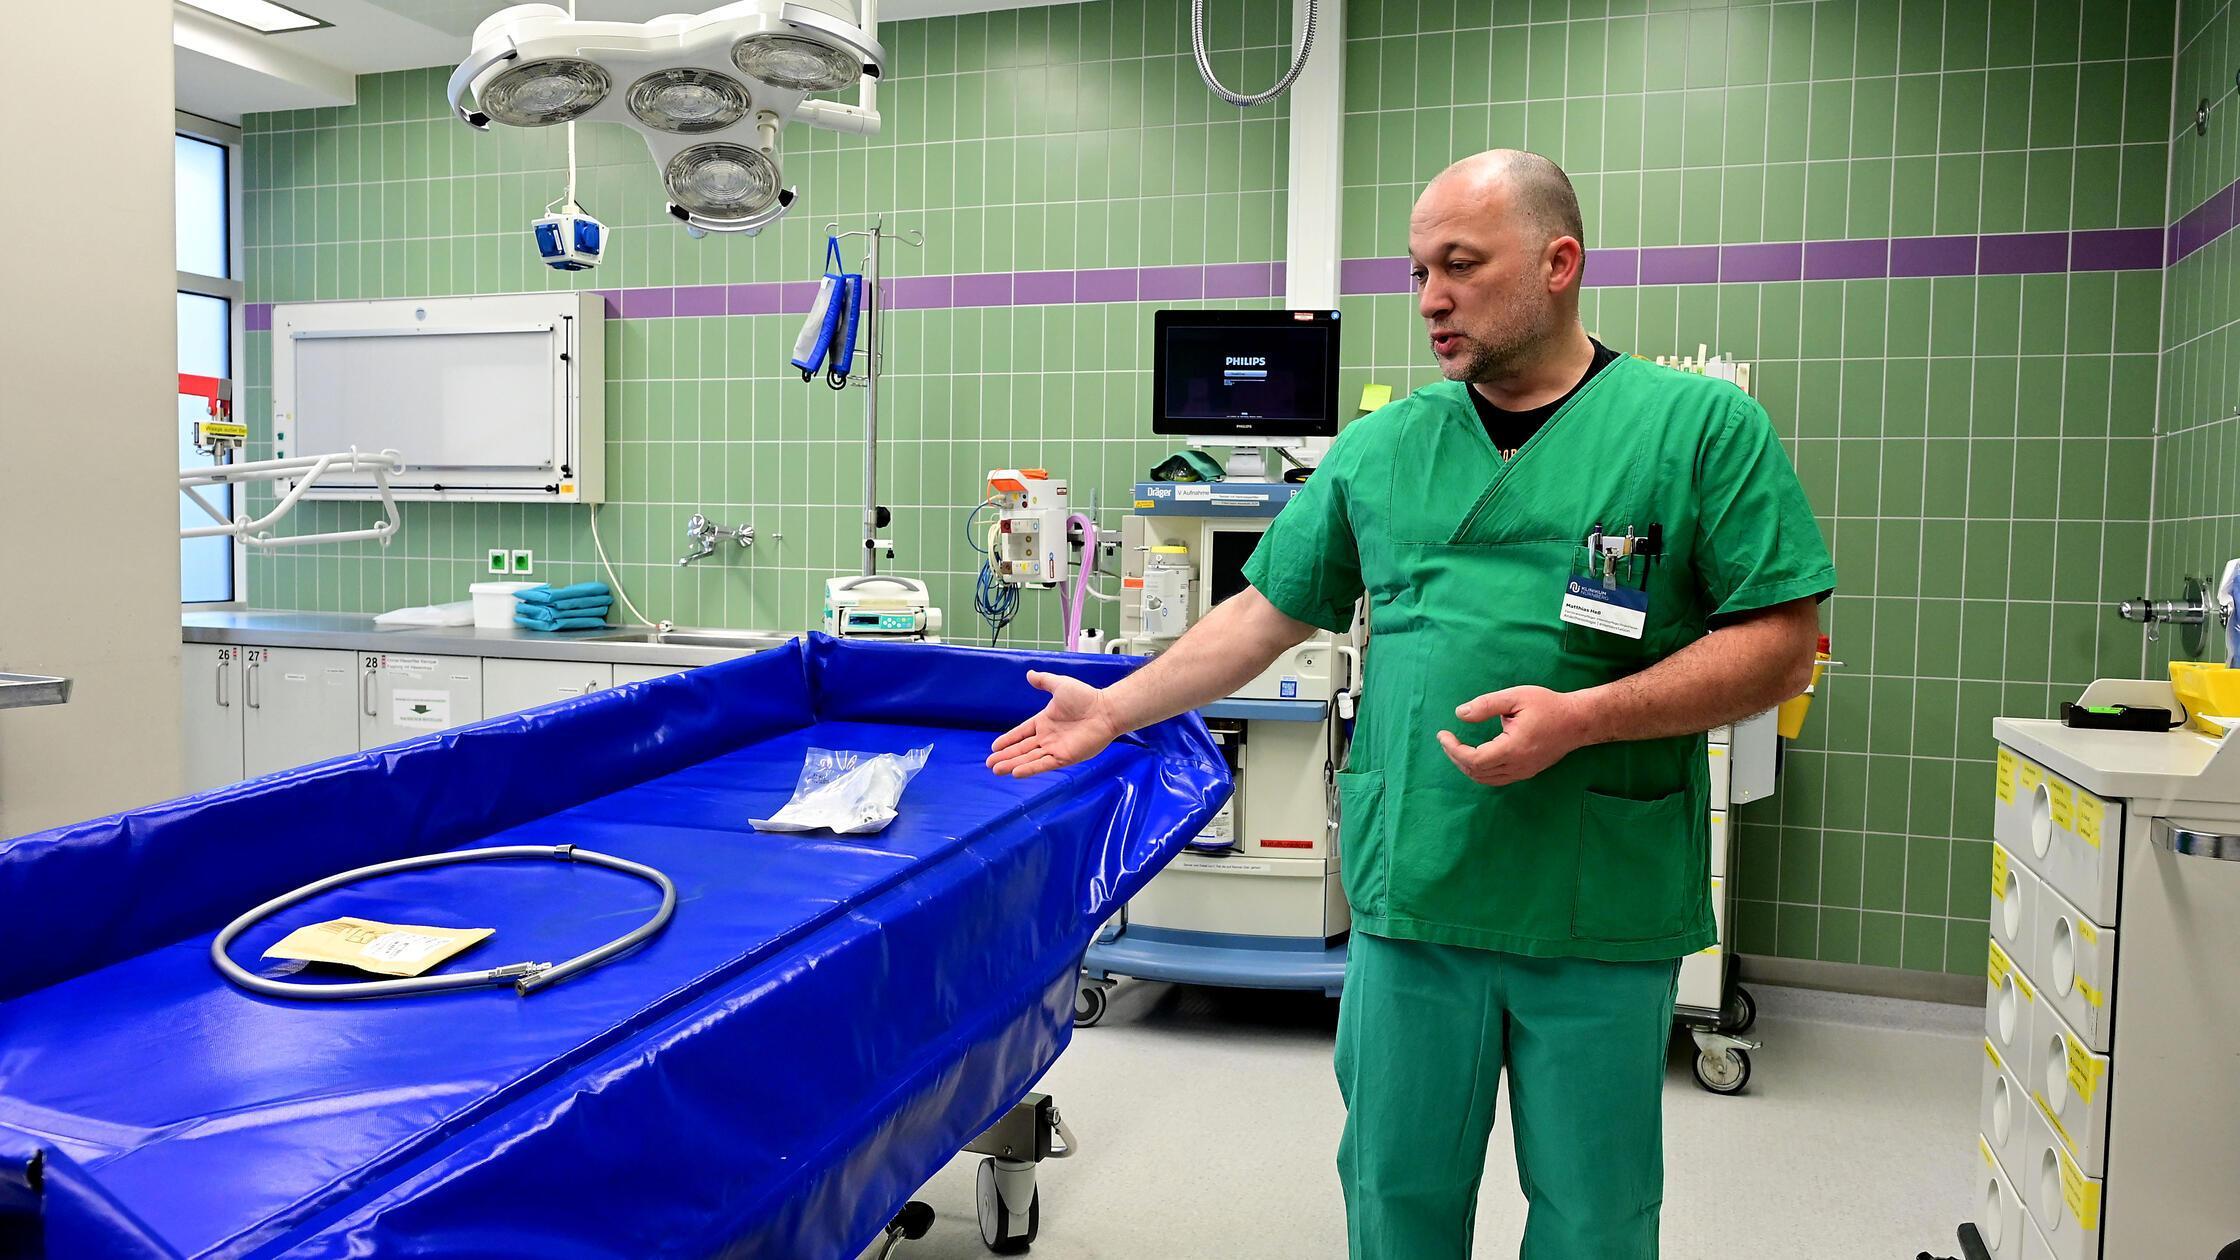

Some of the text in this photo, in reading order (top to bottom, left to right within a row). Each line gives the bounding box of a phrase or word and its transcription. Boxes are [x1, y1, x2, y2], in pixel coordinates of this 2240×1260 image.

[1225, 356, 1266, 366] PHILIPS
[1147, 487, 1171, 498] Dräger
[1565, 603, 1589, 613] Matthias
[218, 649, 229, 660] 26
[248, 651, 260, 661] 27
[365, 657, 378, 668] 28
